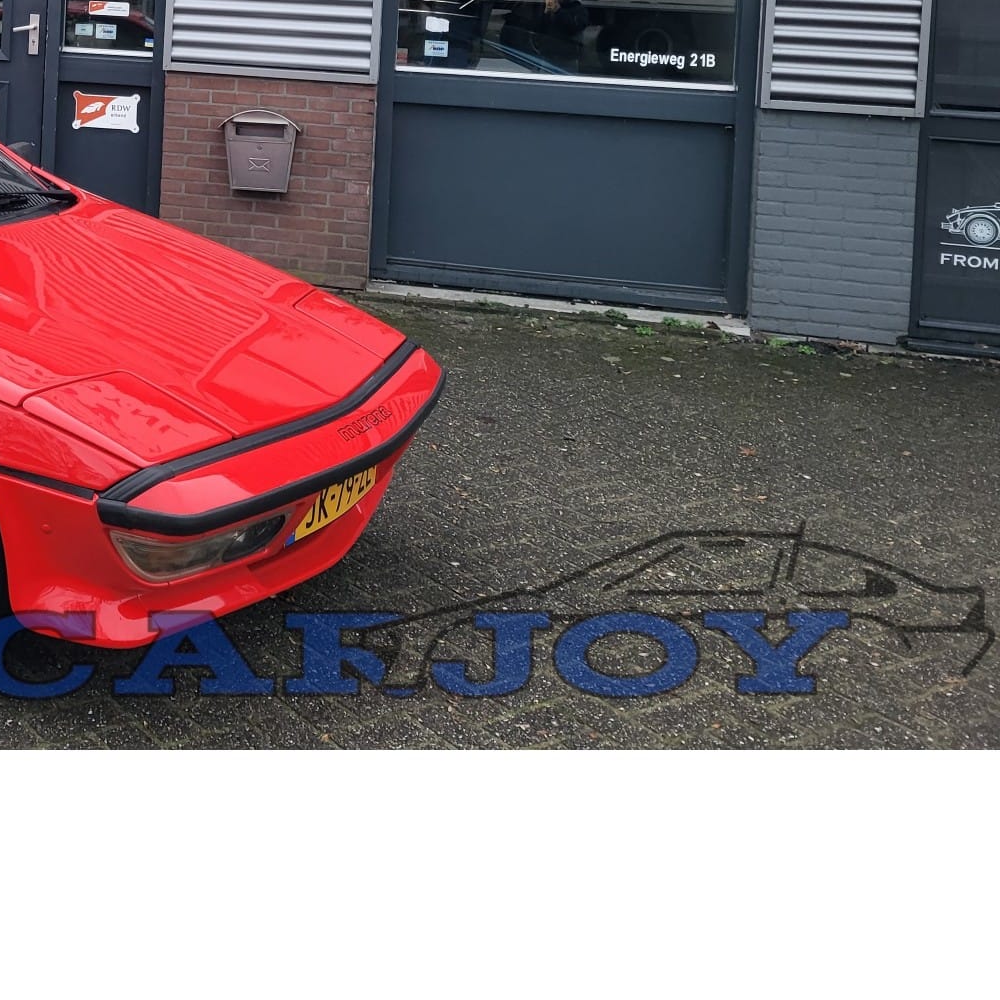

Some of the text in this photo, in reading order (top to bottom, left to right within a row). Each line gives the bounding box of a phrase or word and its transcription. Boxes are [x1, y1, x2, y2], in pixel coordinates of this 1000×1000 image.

[610, 47, 717, 70] Energieweg 21B
[111, 104, 131, 112] RDW
[940, 252, 999, 270] FROM
[337, 405, 392, 441] murena
